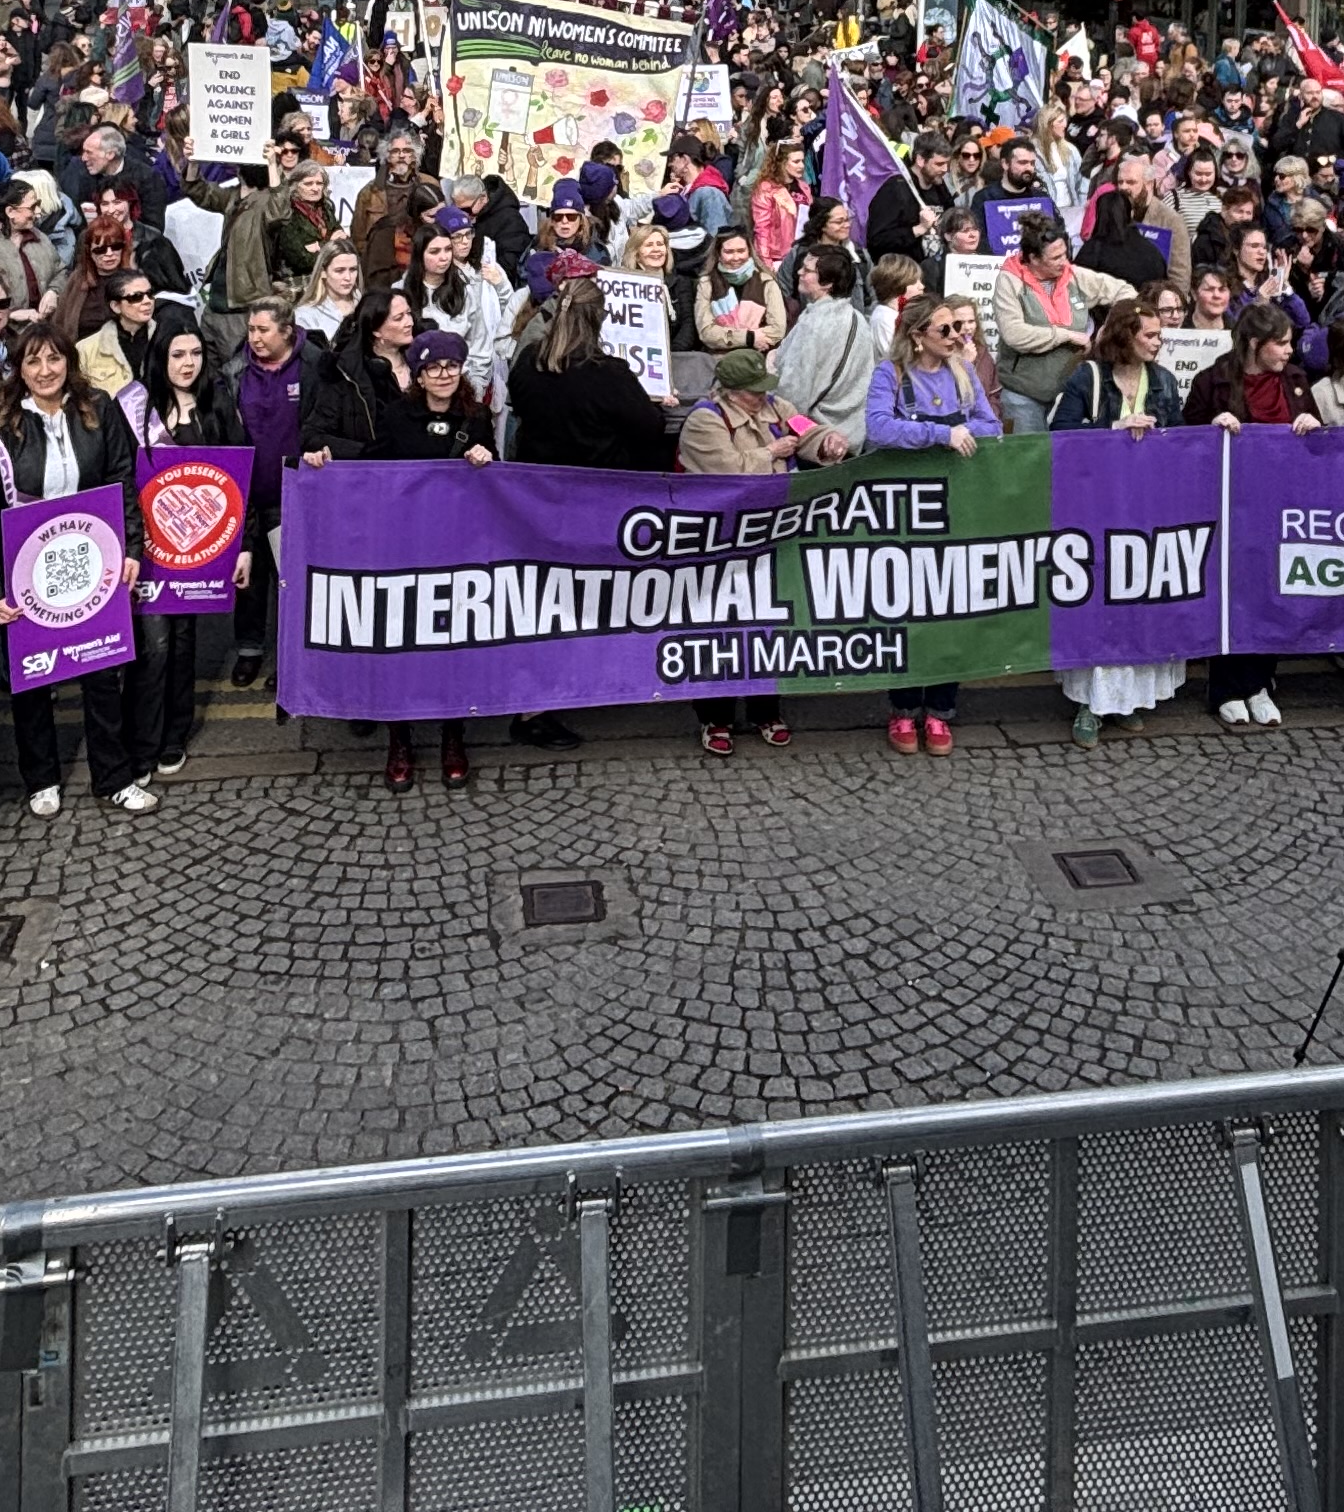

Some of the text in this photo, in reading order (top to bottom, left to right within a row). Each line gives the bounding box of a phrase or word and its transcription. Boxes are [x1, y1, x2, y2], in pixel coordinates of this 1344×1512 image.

[457, 11, 524, 33] UNISON
[528, 15, 547, 38] NI
[548, 18, 616, 46] WOMEN'S
[240, 52, 253, 61] Aid
[540, 39, 671, 71] leave no woman behind
[218, 71, 241, 80] END
[205, 85, 256, 96] VIOLENCE
[207, 100, 254, 111] AGAINST
[209, 114, 252, 125] WOMEN
[211, 129, 250, 140] & GIRLS
[215, 144, 244, 155] NOW
[972, 282, 993, 292] END
[605, 302, 644, 328] WE
[1202, 338, 1218, 348] Aid
[1174, 360, 1199, 372] END
[156, 466, 228, 486] YOU DESERVE
[623, 483, 944, 557] CELEBRATE
[38, 519, 93, 543] WE HAVE
[173, 516, 238, 564] RELATIONSHIP
[208, 579, 225, 589] Aid
[310, 527, 1211, 648] INTERNATIONAL WOMEN'S DAY
[21, 568, 116, 623] SOMETHING TO SAY
[22, 647, 59, 676] say
[62, 638, 103, 662] Women's
[104, 633, 121, 645] Aid
[662, 631, 903, 678] 8TH MARCH
